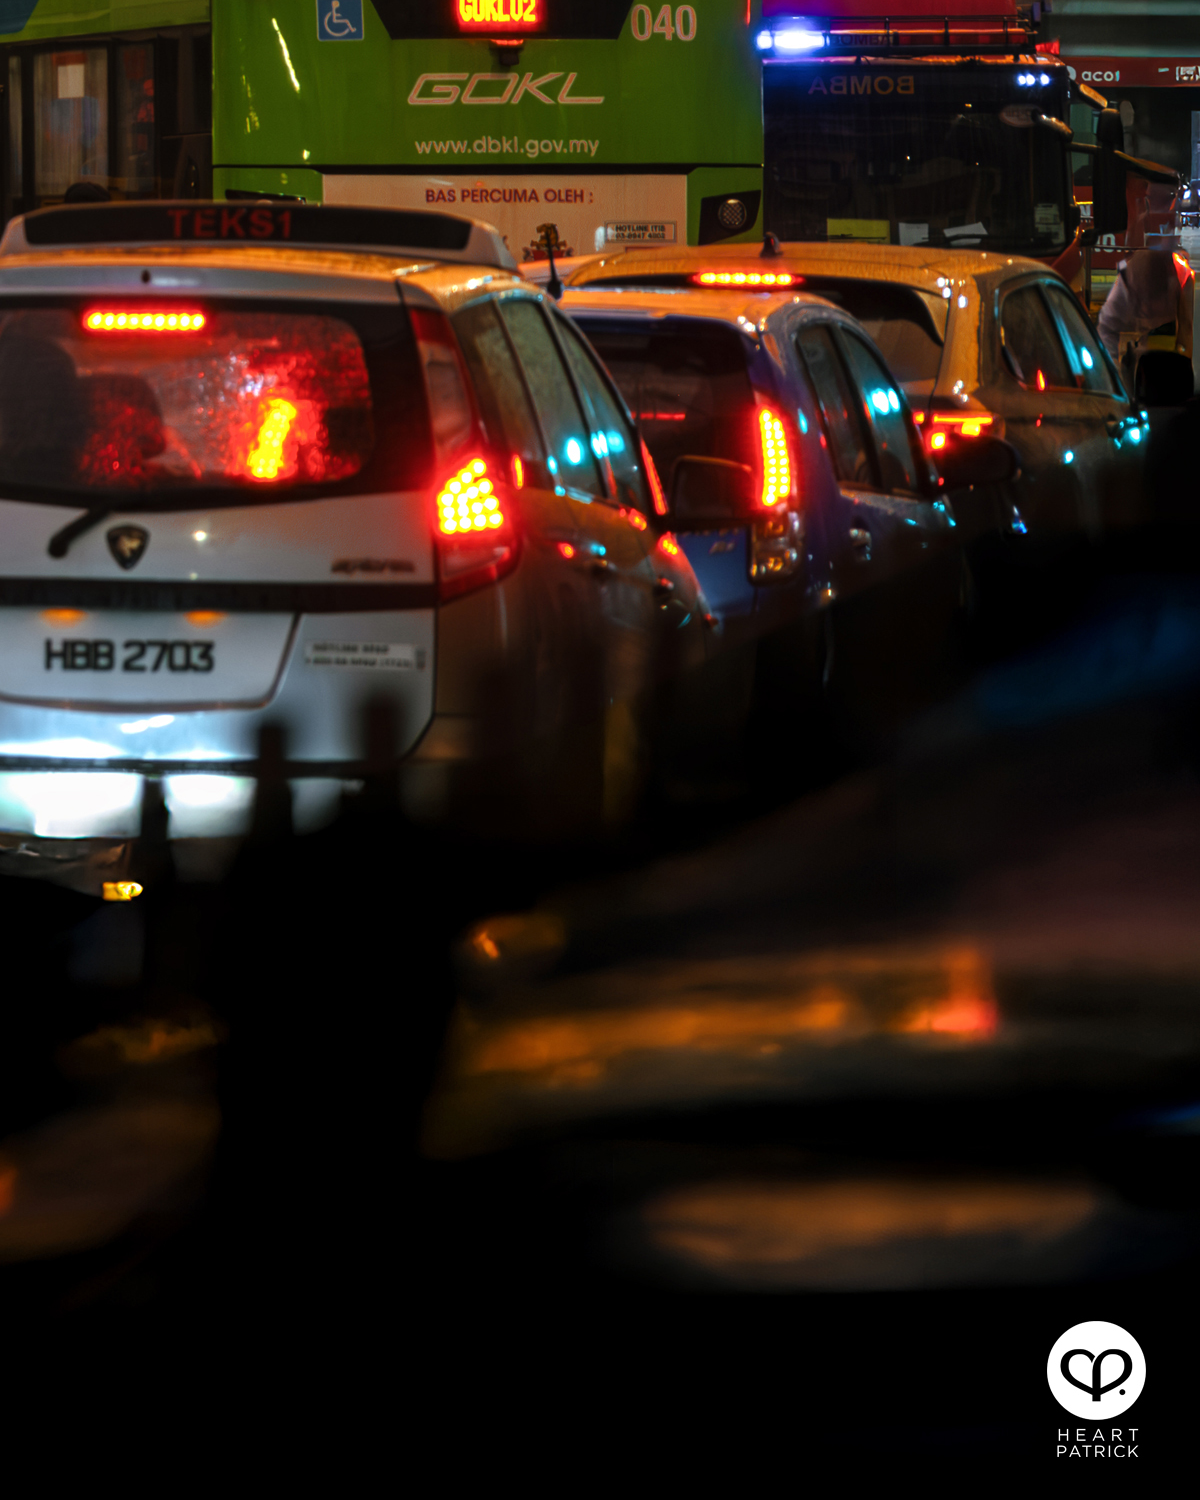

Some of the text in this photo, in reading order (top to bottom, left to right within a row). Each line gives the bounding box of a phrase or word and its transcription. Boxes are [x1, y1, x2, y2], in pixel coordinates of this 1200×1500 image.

[630, 4, 698, 41] 040
[407, 71, 605, 105] GOKL
[415, 136, 600, 158] www.dbkl.gov.my
[425, 188, 457, 204] BAS
[460, 188, 540, 204] PERCUMA
[543, 188, 585, 204] OLEH
[615, 224, 649, 232] HOTLINE
[44, 638, 216, 673] HBB 2703
